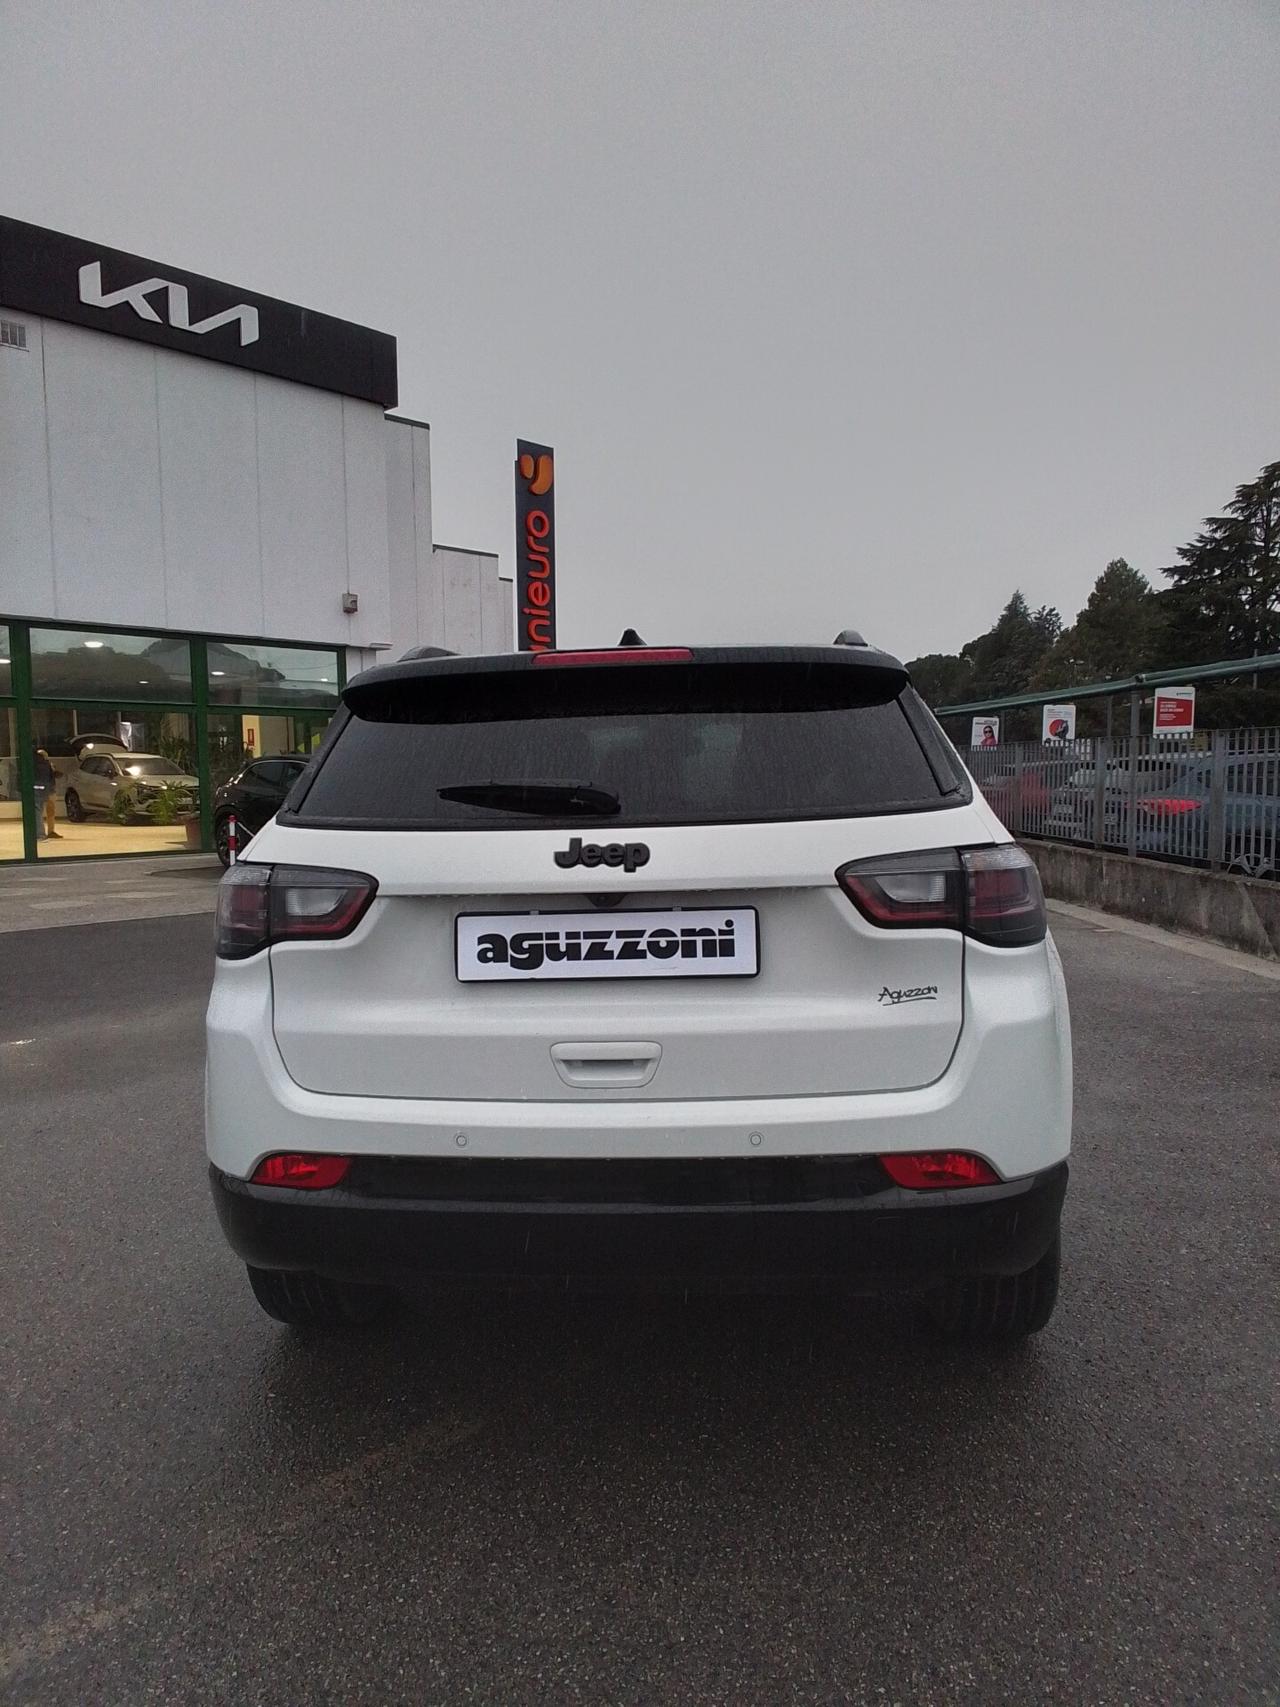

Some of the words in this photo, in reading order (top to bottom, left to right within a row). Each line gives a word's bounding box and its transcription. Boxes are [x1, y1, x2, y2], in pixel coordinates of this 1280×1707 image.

[79, 261, 259, 346] KIA
[523, 510, 551, 651] nieuro
[554, 837, 650, 873] Jeep
[476, 919, 735, 970] aguzzoni
